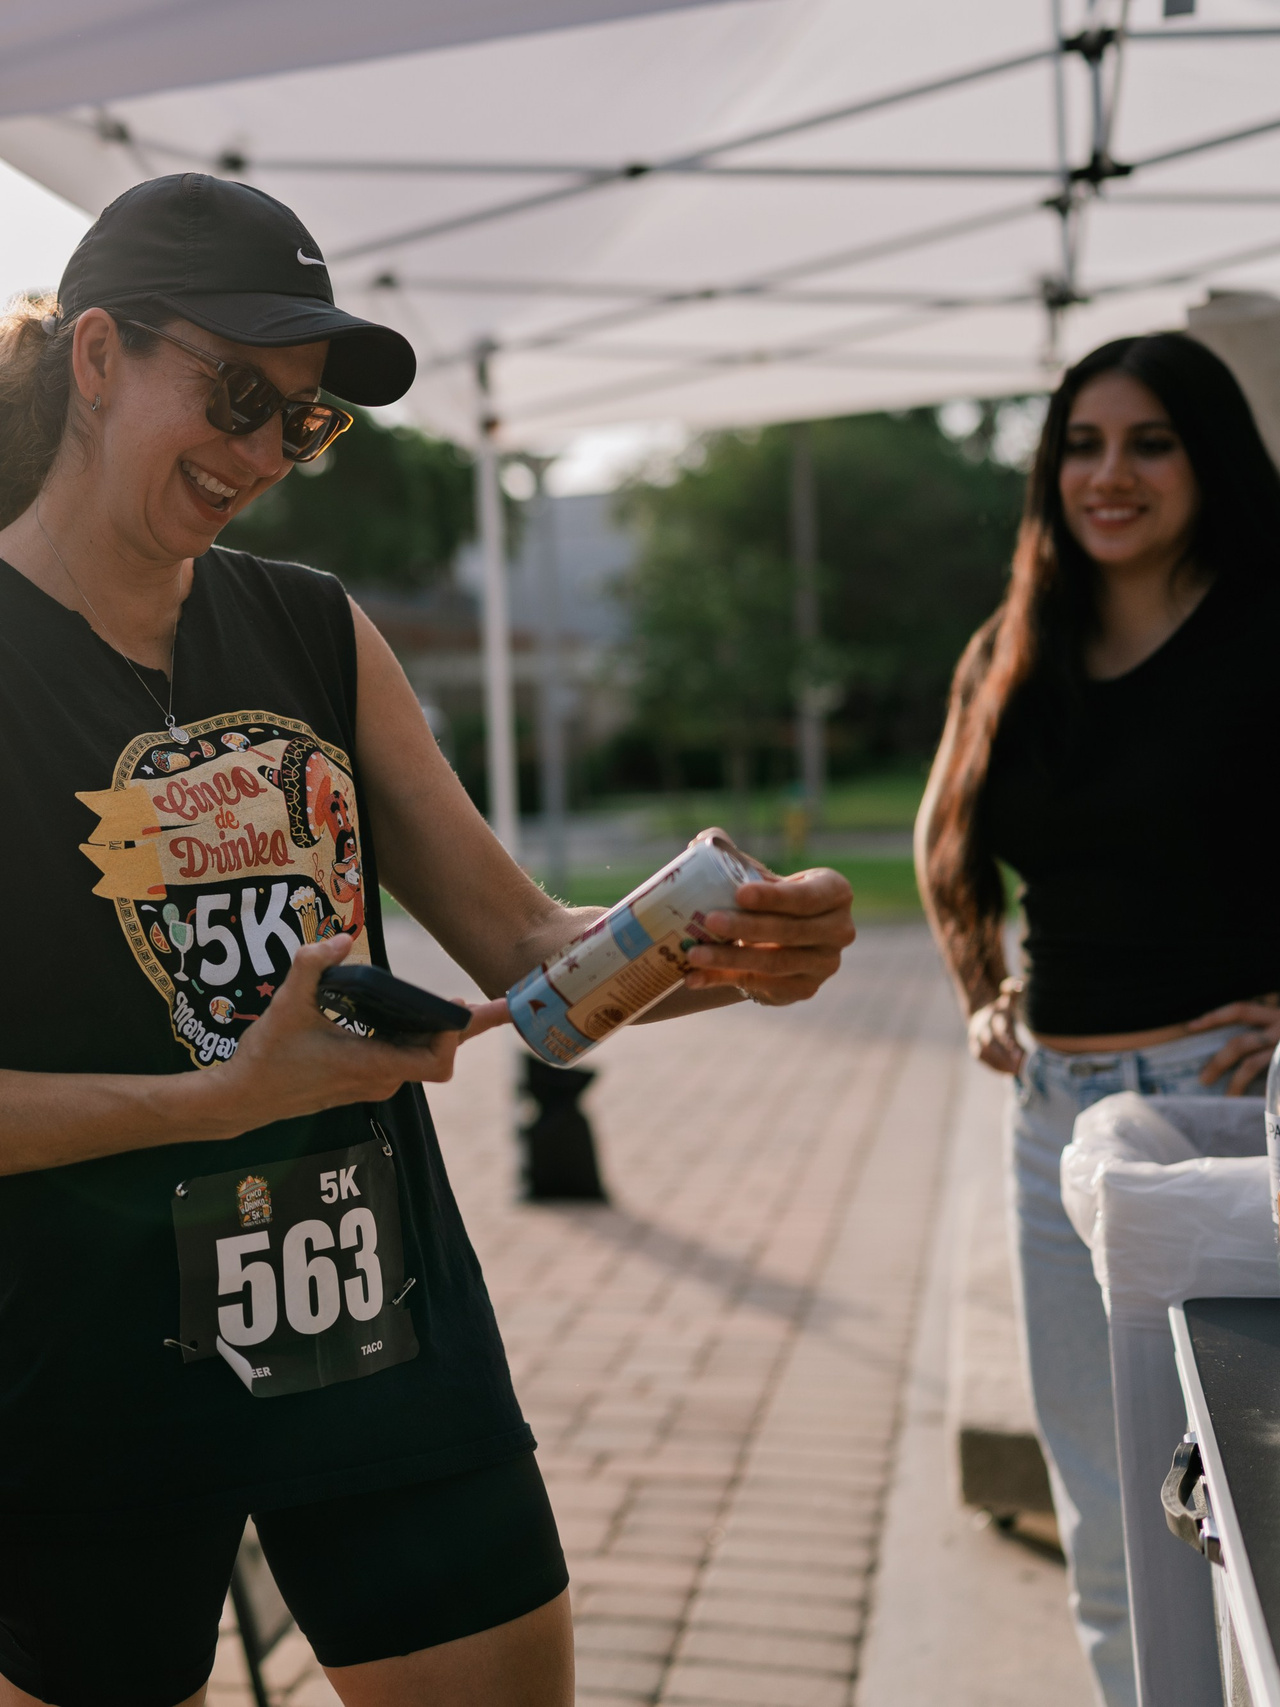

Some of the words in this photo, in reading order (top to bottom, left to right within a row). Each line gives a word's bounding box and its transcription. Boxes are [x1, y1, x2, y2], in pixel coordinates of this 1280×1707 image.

[152, 766, 268, 821] Cinco
[215, 807, 240, 830] de
[169, 823, 295, 878] Drinko
[196, 882, 303, 986] 5K
[173, 991, 239, 1062] Margar
[320, 1165, 361, 1204] 5K
[216, 1207, 383, 1346] 563
[251, 1366, 272, 1379] EER
[361, 1340, 383, 1356] TACO
